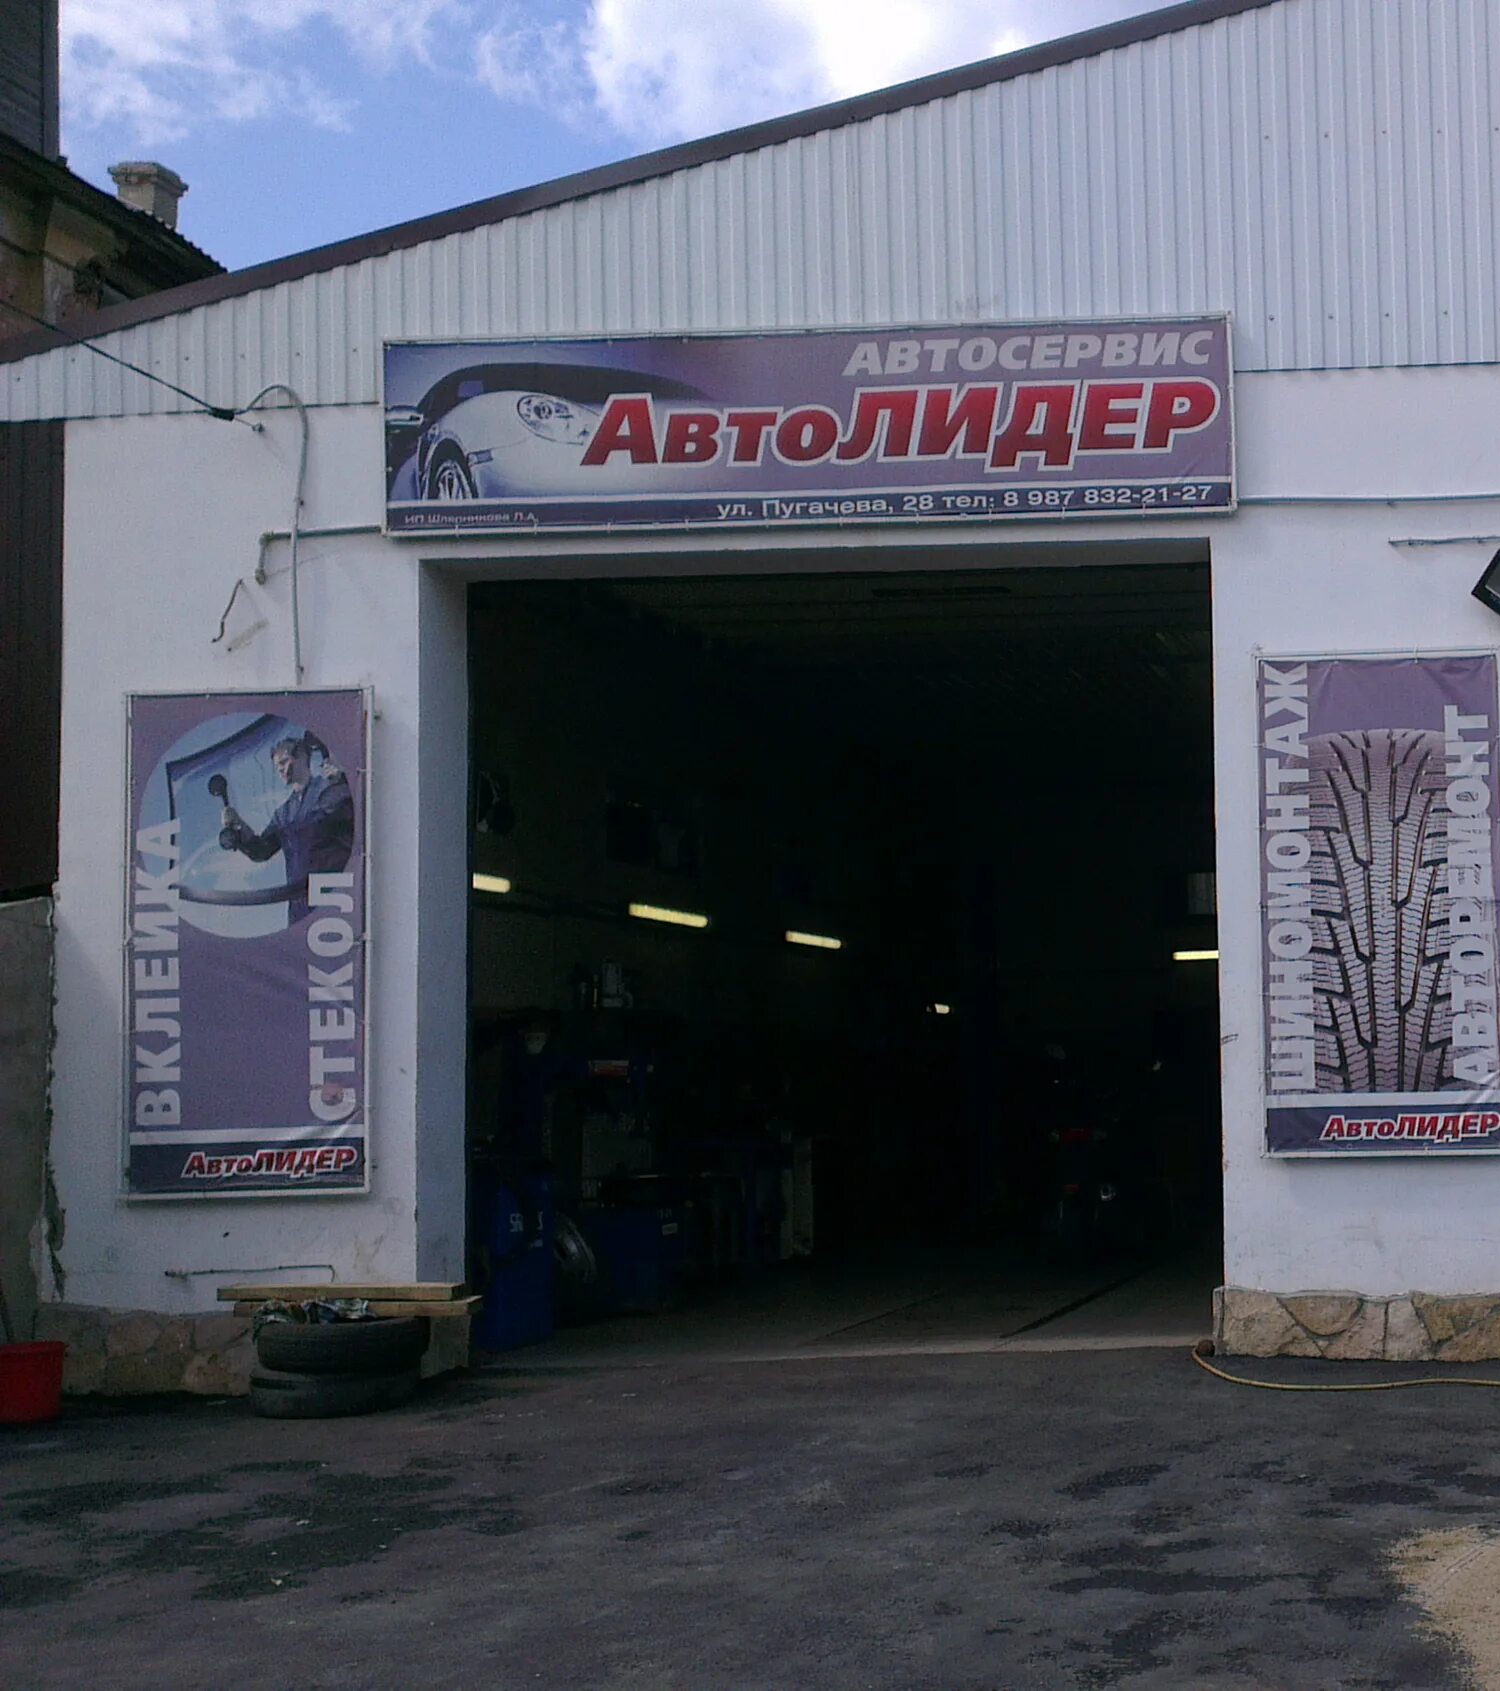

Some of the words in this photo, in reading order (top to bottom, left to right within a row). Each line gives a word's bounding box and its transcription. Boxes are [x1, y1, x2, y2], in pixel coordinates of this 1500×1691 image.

[842, 330, 1213, 376] АВТОСЕРВИС
[578, 378, 1219, 472] АвтоЛИДЕР
[405, 514, 425, 524] ИП
[717, 503, 752, 519] ул.
[762, 498, 894, 519] Пугачева,
[903, 494, 934, 511] 28
[1003, 491, 1019, 507] 8
[1028, 488, 1075, 506] 987
[1084, 485, 1212, 505] 832-21-27
[1263, 663, 1316, 1090] ШИНОМОНТАЖ
[1444, 704, 1495, 1086] АВТОРЕМОНТ
[307, 871, 356, 1122] СТЕКОЛ
[182, 1146, 357, 1179] АвтоЛИДЕР
